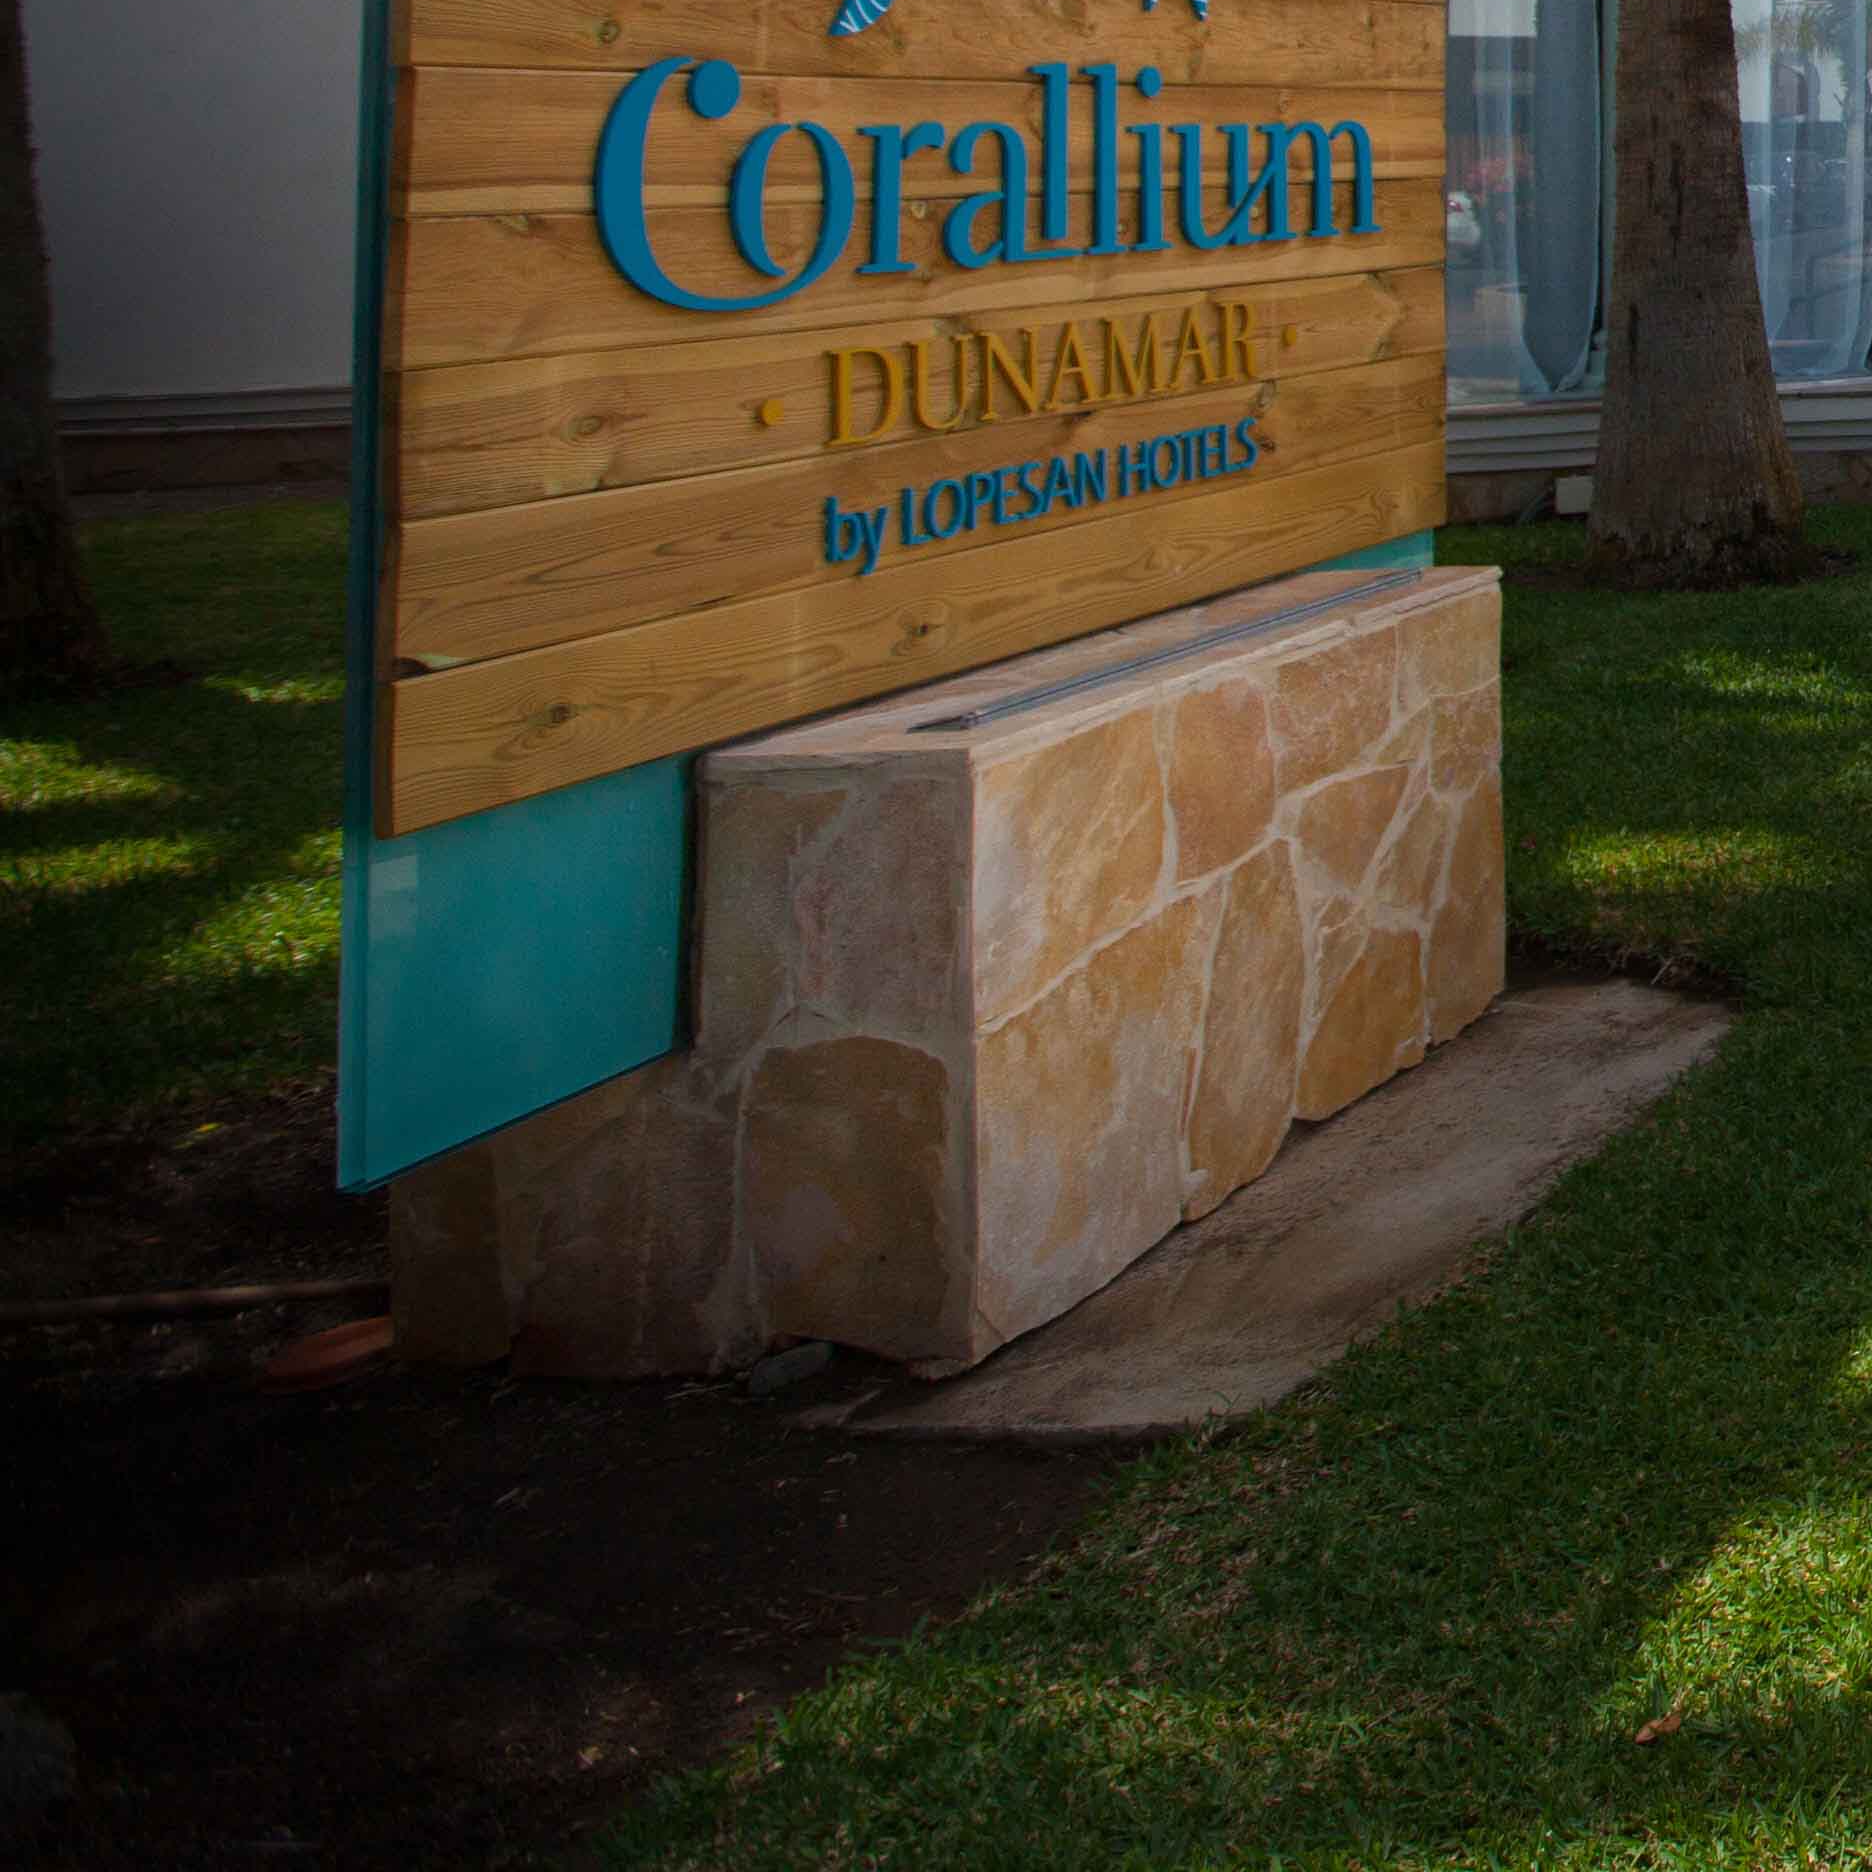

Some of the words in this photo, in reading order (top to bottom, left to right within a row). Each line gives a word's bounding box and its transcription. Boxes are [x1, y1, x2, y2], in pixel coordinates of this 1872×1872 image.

[595, 55, 1382, 312] Corallium
[823, 298, 1257, 449] DUNAMAR
[823, 495, 889, 576] by
[900, 446, 1109, 548] LOPESAN
[1118, 416, 1260, 497] HOTELS
